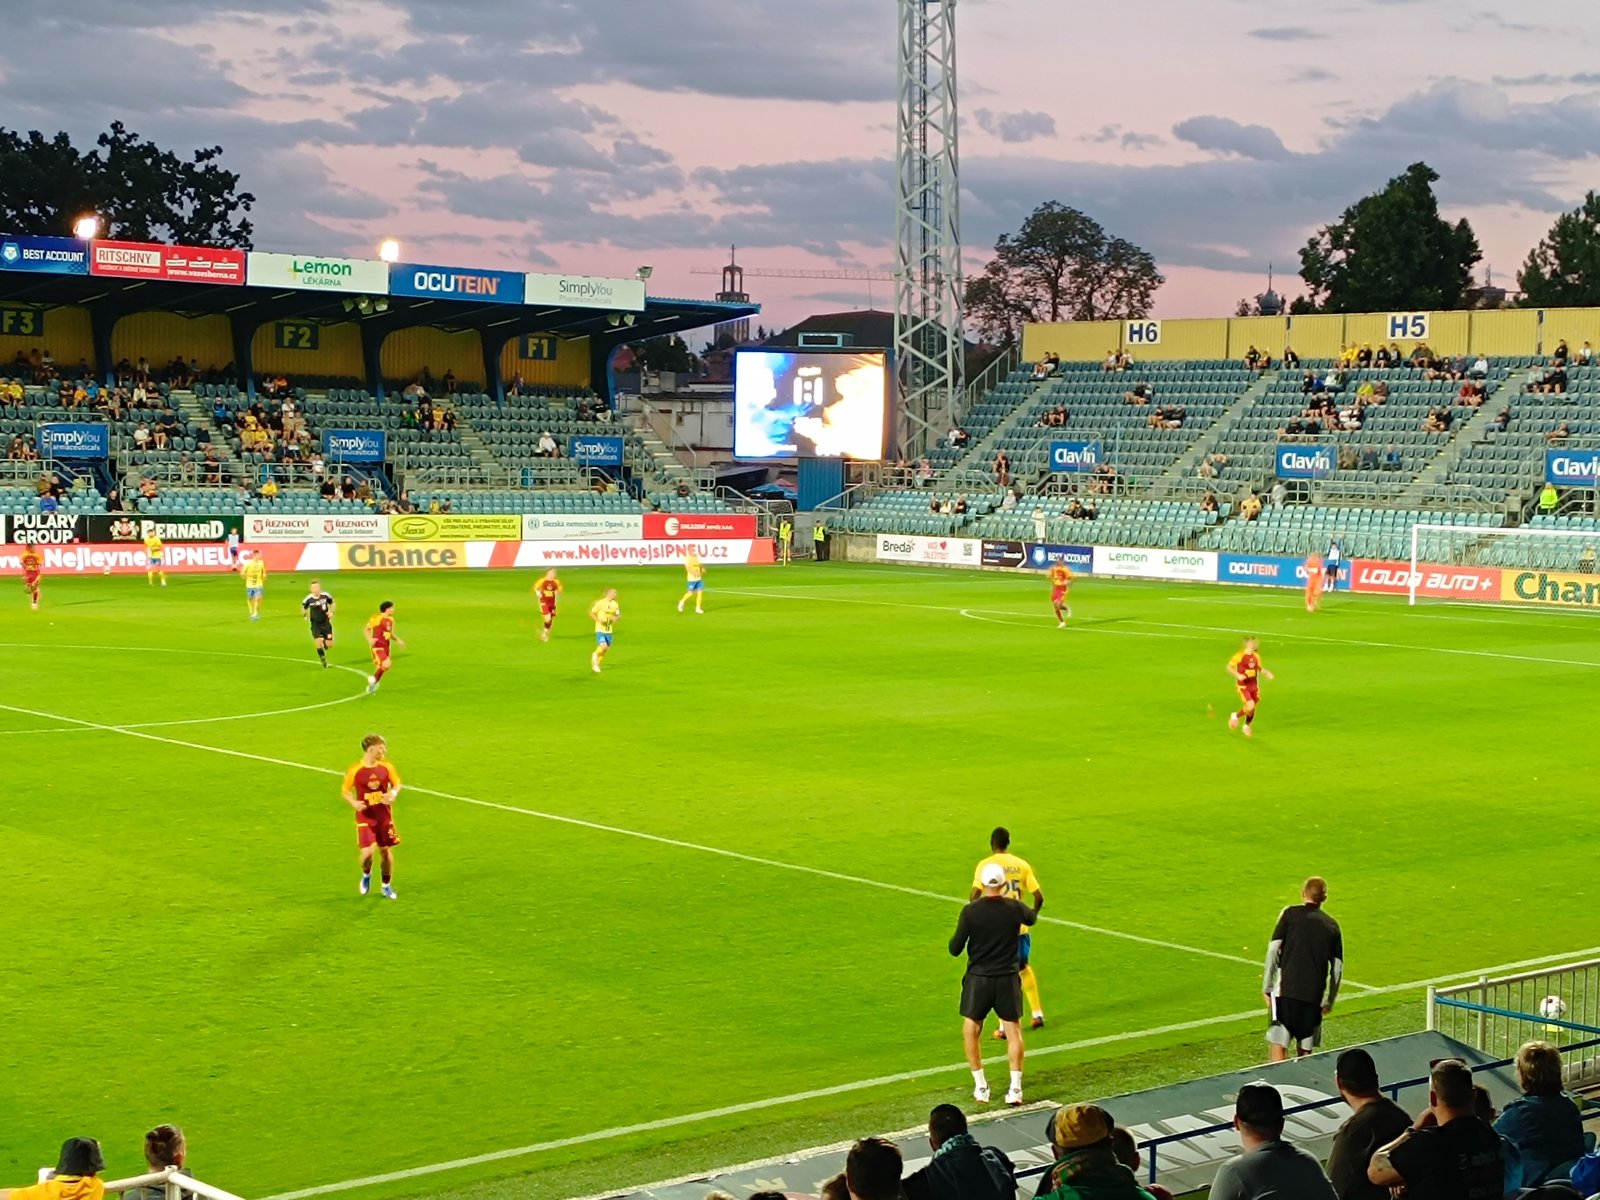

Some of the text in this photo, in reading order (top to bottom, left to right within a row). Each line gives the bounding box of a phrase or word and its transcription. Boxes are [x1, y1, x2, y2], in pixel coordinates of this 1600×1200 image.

[23, 249, 84, 262] BEST ACCOUNT
[99, 250, 152, 264] RITSCHNY
[293, 260, 352, 276] Lemon
[303, 276, 342, 287] LÉKÁRNA
[414, 271, 498, 295] OCUTEIN
[559, 280, 613, 299] SimplyYou
[1129, 323, 1158, 342] H6
[1391, 315, 1426, 338] H5
[528, 338, 548, 358] F1
[42, 430, 100, 445] SimplyYou
[329, 436, 379, 450] SimplyYou
[575, 442, 618, 455] SimplyYou
[1055, 446, 1096, 464] Clavin
[1282, 451, 1330, 469] Clavin
[13, 514, 79, 529] PULARY
[265, 519, 309, 528] ŘEZNICTVÍ
[335, 519, 378, 528] ŘEZNICTVÍ
[543, 520, 564, 528] Slezská
[141, 520, 224, 539] BERNARD
[883, 540, 912, 553] Breda
[348, 544, 457, 567] Chance
[1048, 552, 1091, 563] BEST ACCOUNT
[1108, 552, 1148, 562] Lemon
[1164, 555, 1204, 566] Lemon
[1229, 562, 1277, 576] OCUTEIN
